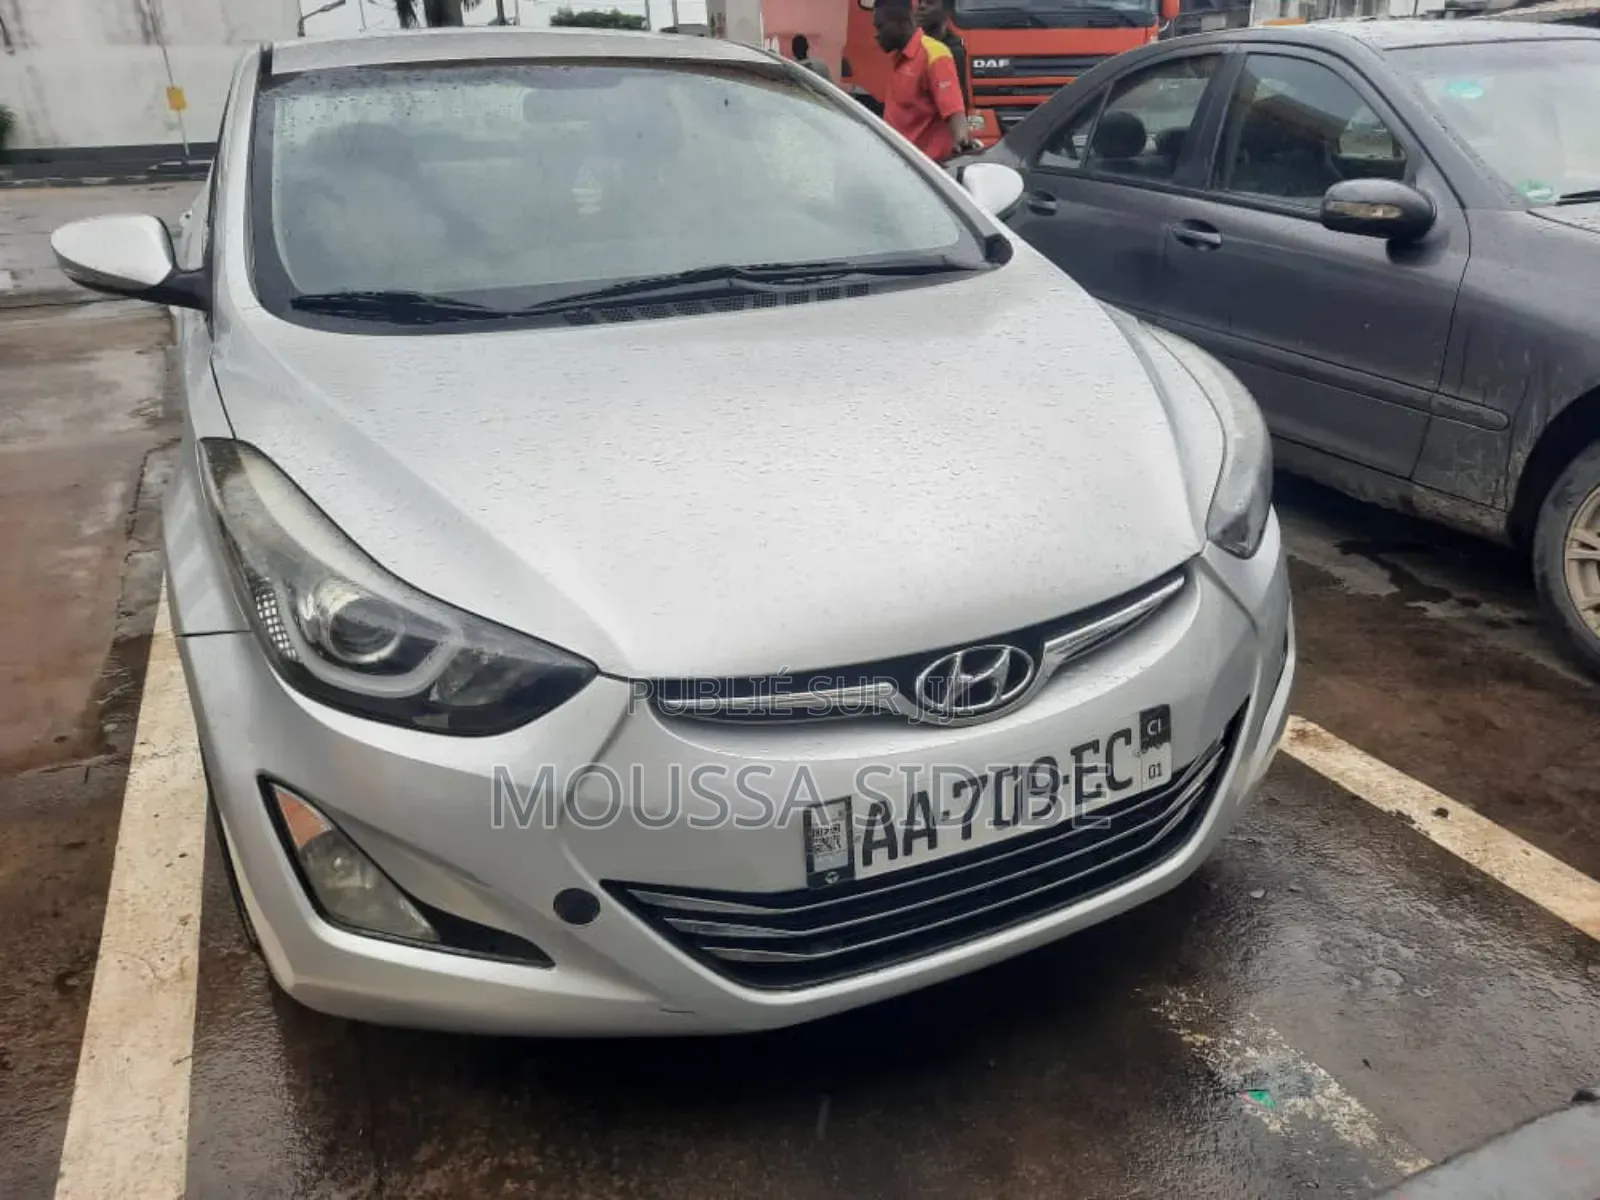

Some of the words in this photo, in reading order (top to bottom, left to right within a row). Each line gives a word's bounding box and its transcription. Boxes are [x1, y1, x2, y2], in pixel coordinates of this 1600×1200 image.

[972, 58, 1010, 68] DAF
[1147, 717, 1161, 736] CI
[1148, 763, 1162, 779] 01
